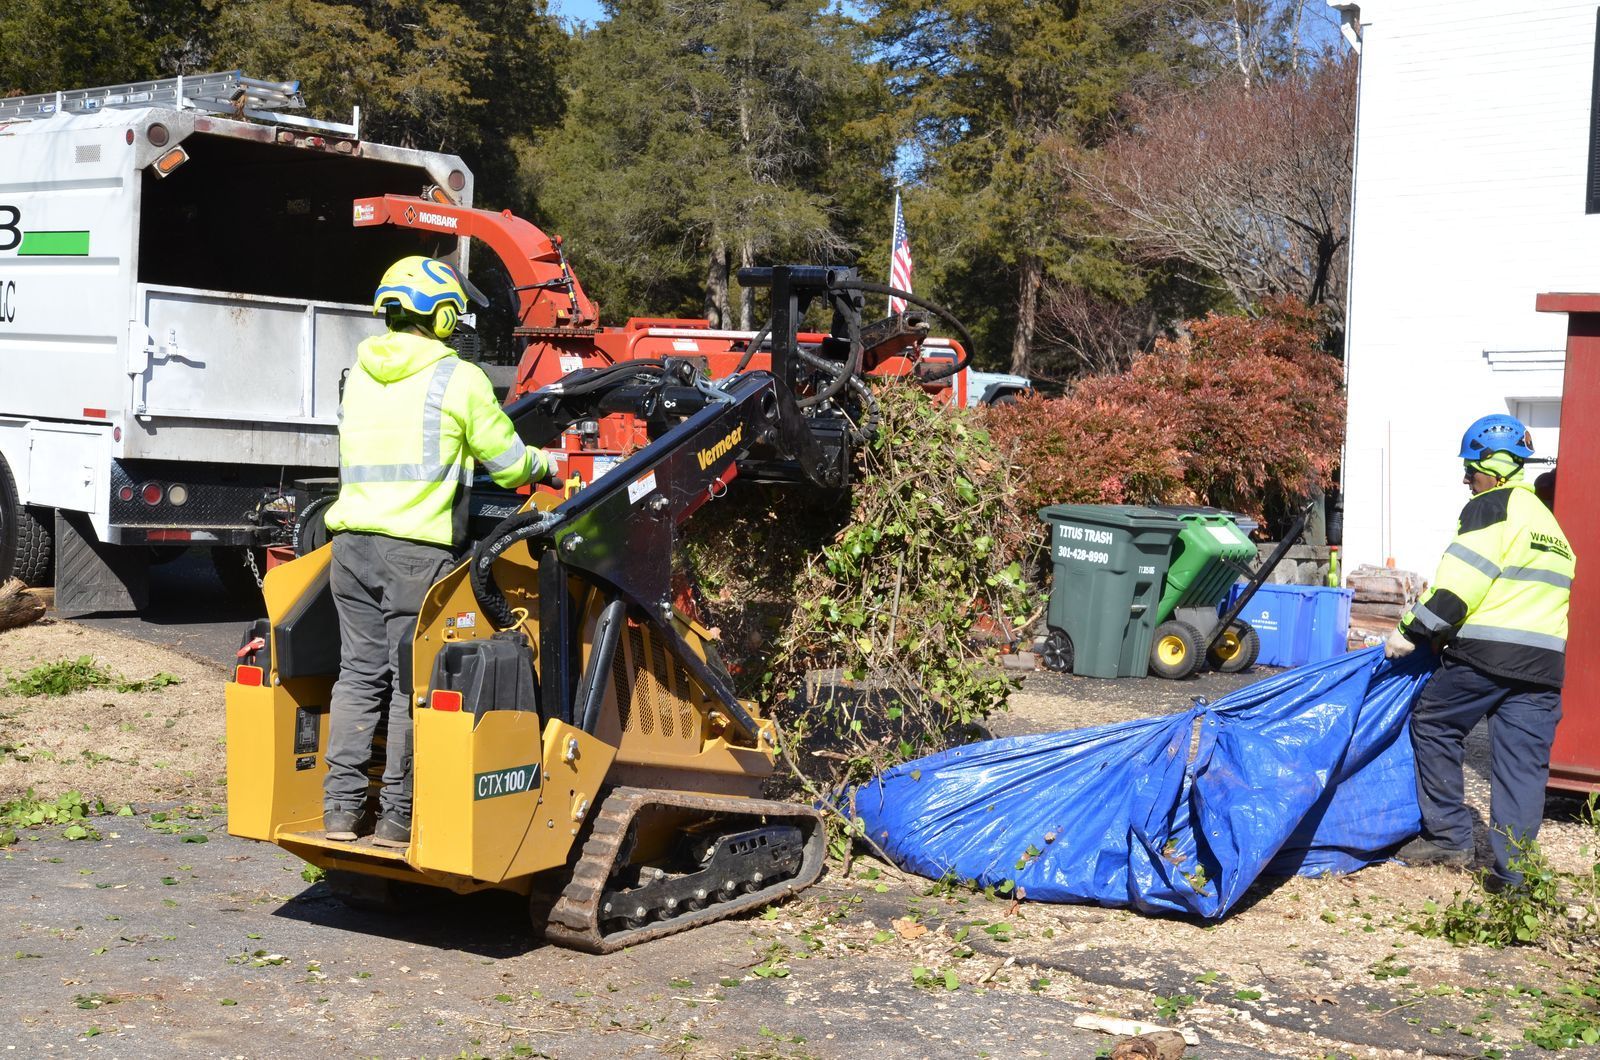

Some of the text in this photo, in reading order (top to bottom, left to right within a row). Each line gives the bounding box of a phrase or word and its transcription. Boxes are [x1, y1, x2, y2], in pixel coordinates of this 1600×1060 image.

[419, 211, 458, 229] MORBARK
[697, 425, 742, 471] Vermeer
[1059, 524, 1113, 545] TITUS TRASH
[1058, 545, 1109, 565] 301-428-8990
